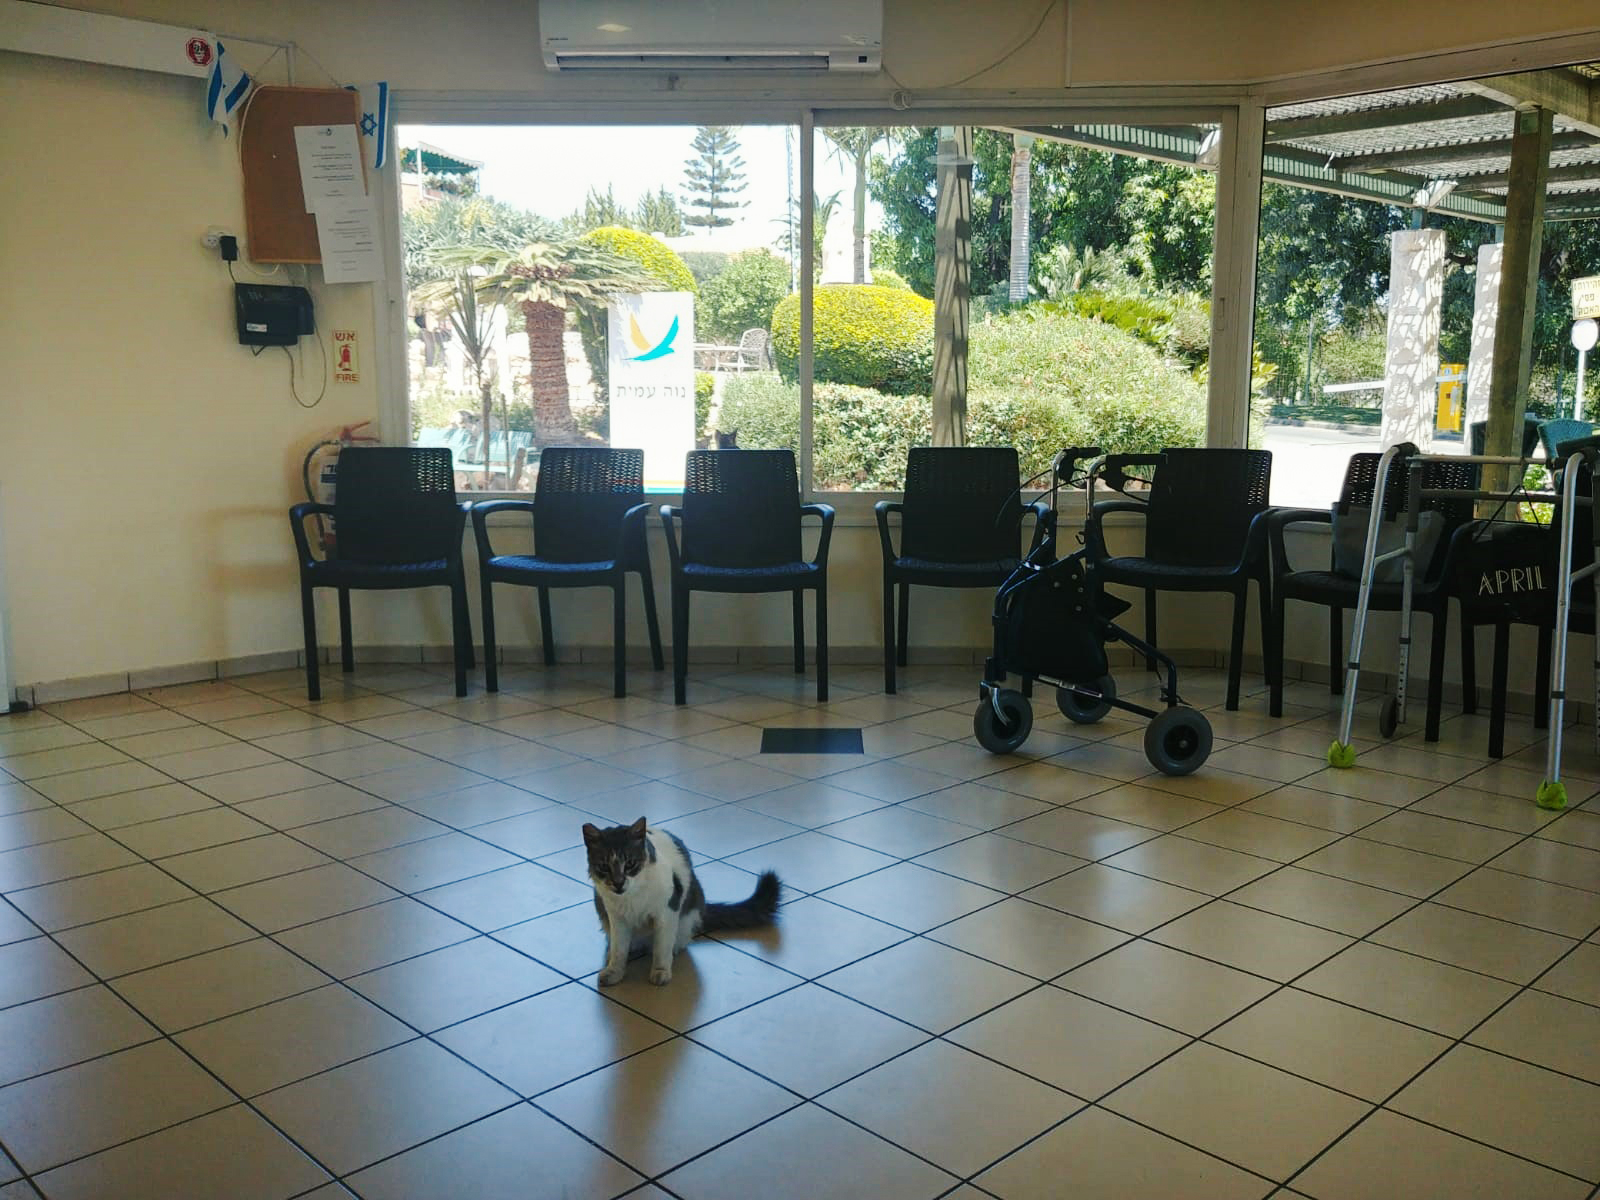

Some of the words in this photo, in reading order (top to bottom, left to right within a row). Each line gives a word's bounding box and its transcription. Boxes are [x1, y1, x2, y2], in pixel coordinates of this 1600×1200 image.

[335, 332, 355, 341] אש
[335, 373, 359, 382] FIRE
[616, 386, 655, 399] עמית
[663, 386, 686, 398] נוה
[1478, 565, 1548, 596] APRIL
